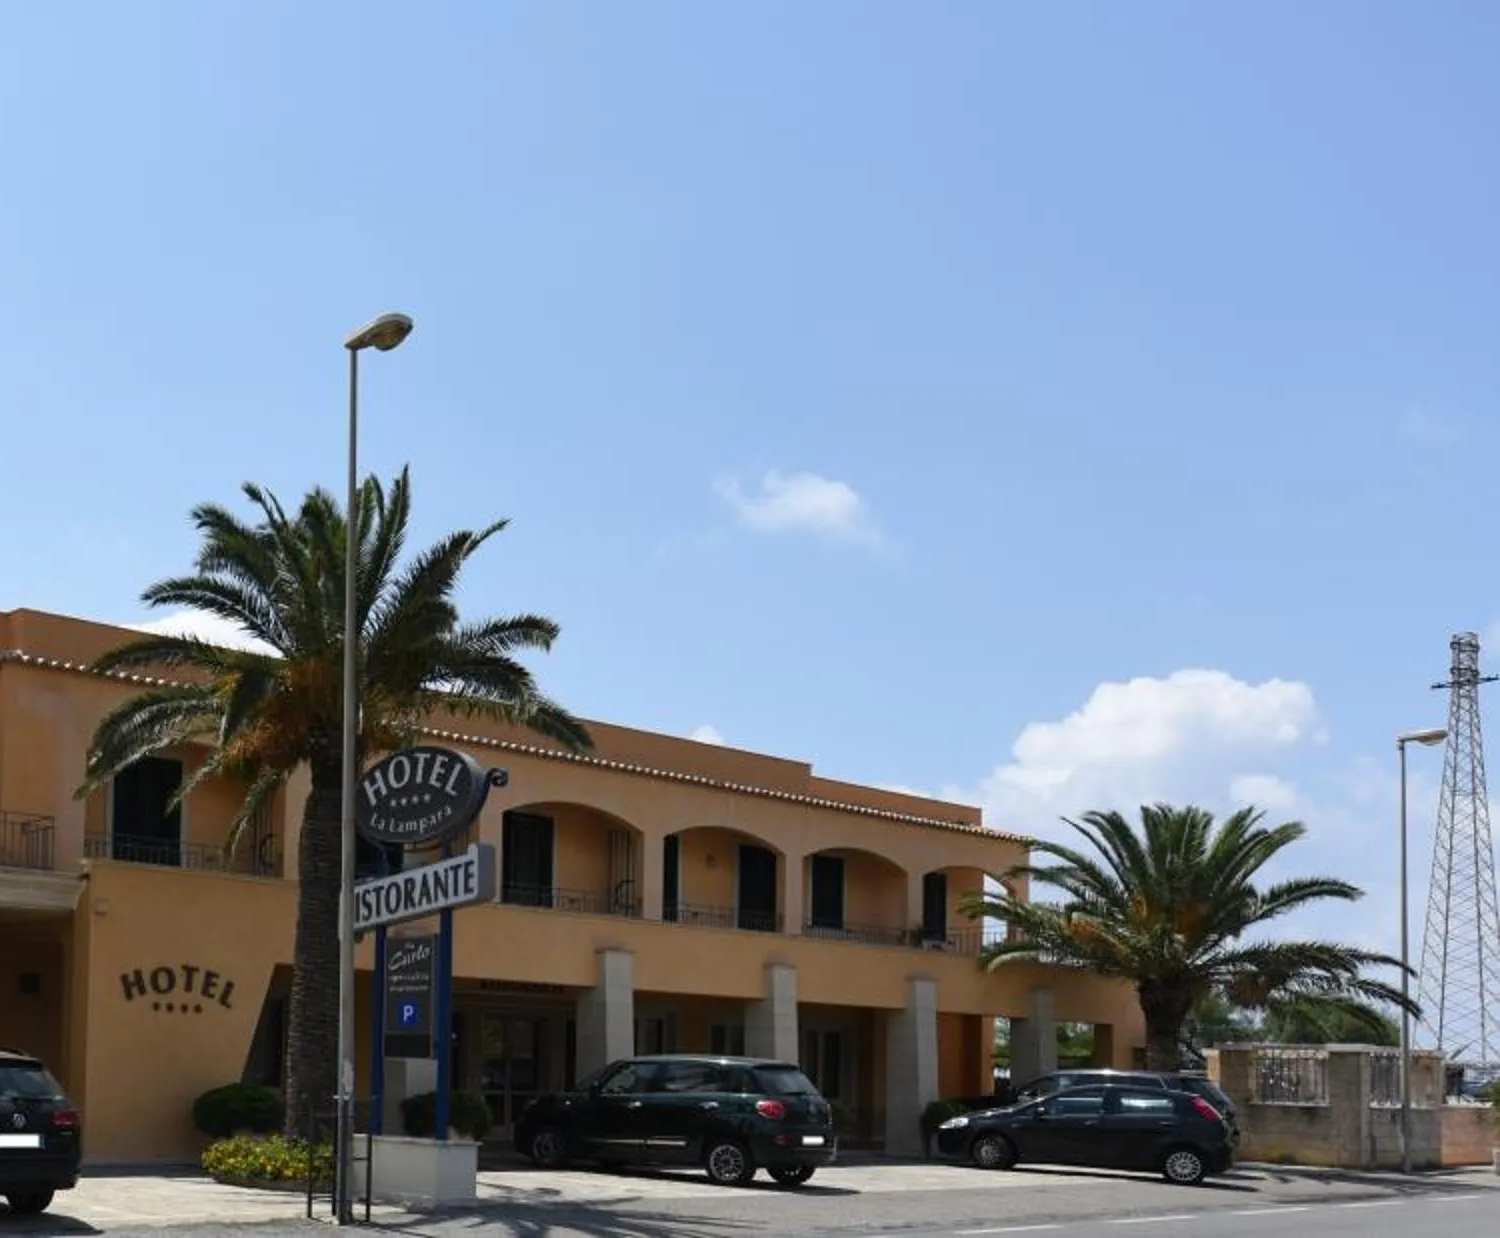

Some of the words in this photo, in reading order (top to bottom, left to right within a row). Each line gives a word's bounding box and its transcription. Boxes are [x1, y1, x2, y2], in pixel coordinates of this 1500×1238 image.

[363, 752, 465, 806] HOTEL
[370, 811, 385, 831] La
[389, 805, 452, 836] Lampara
[355, 859, 475, 923] ISTORANTE
[120, 963, 235, 1010] HOTEL
[403, 1004, 414, 1022] P
